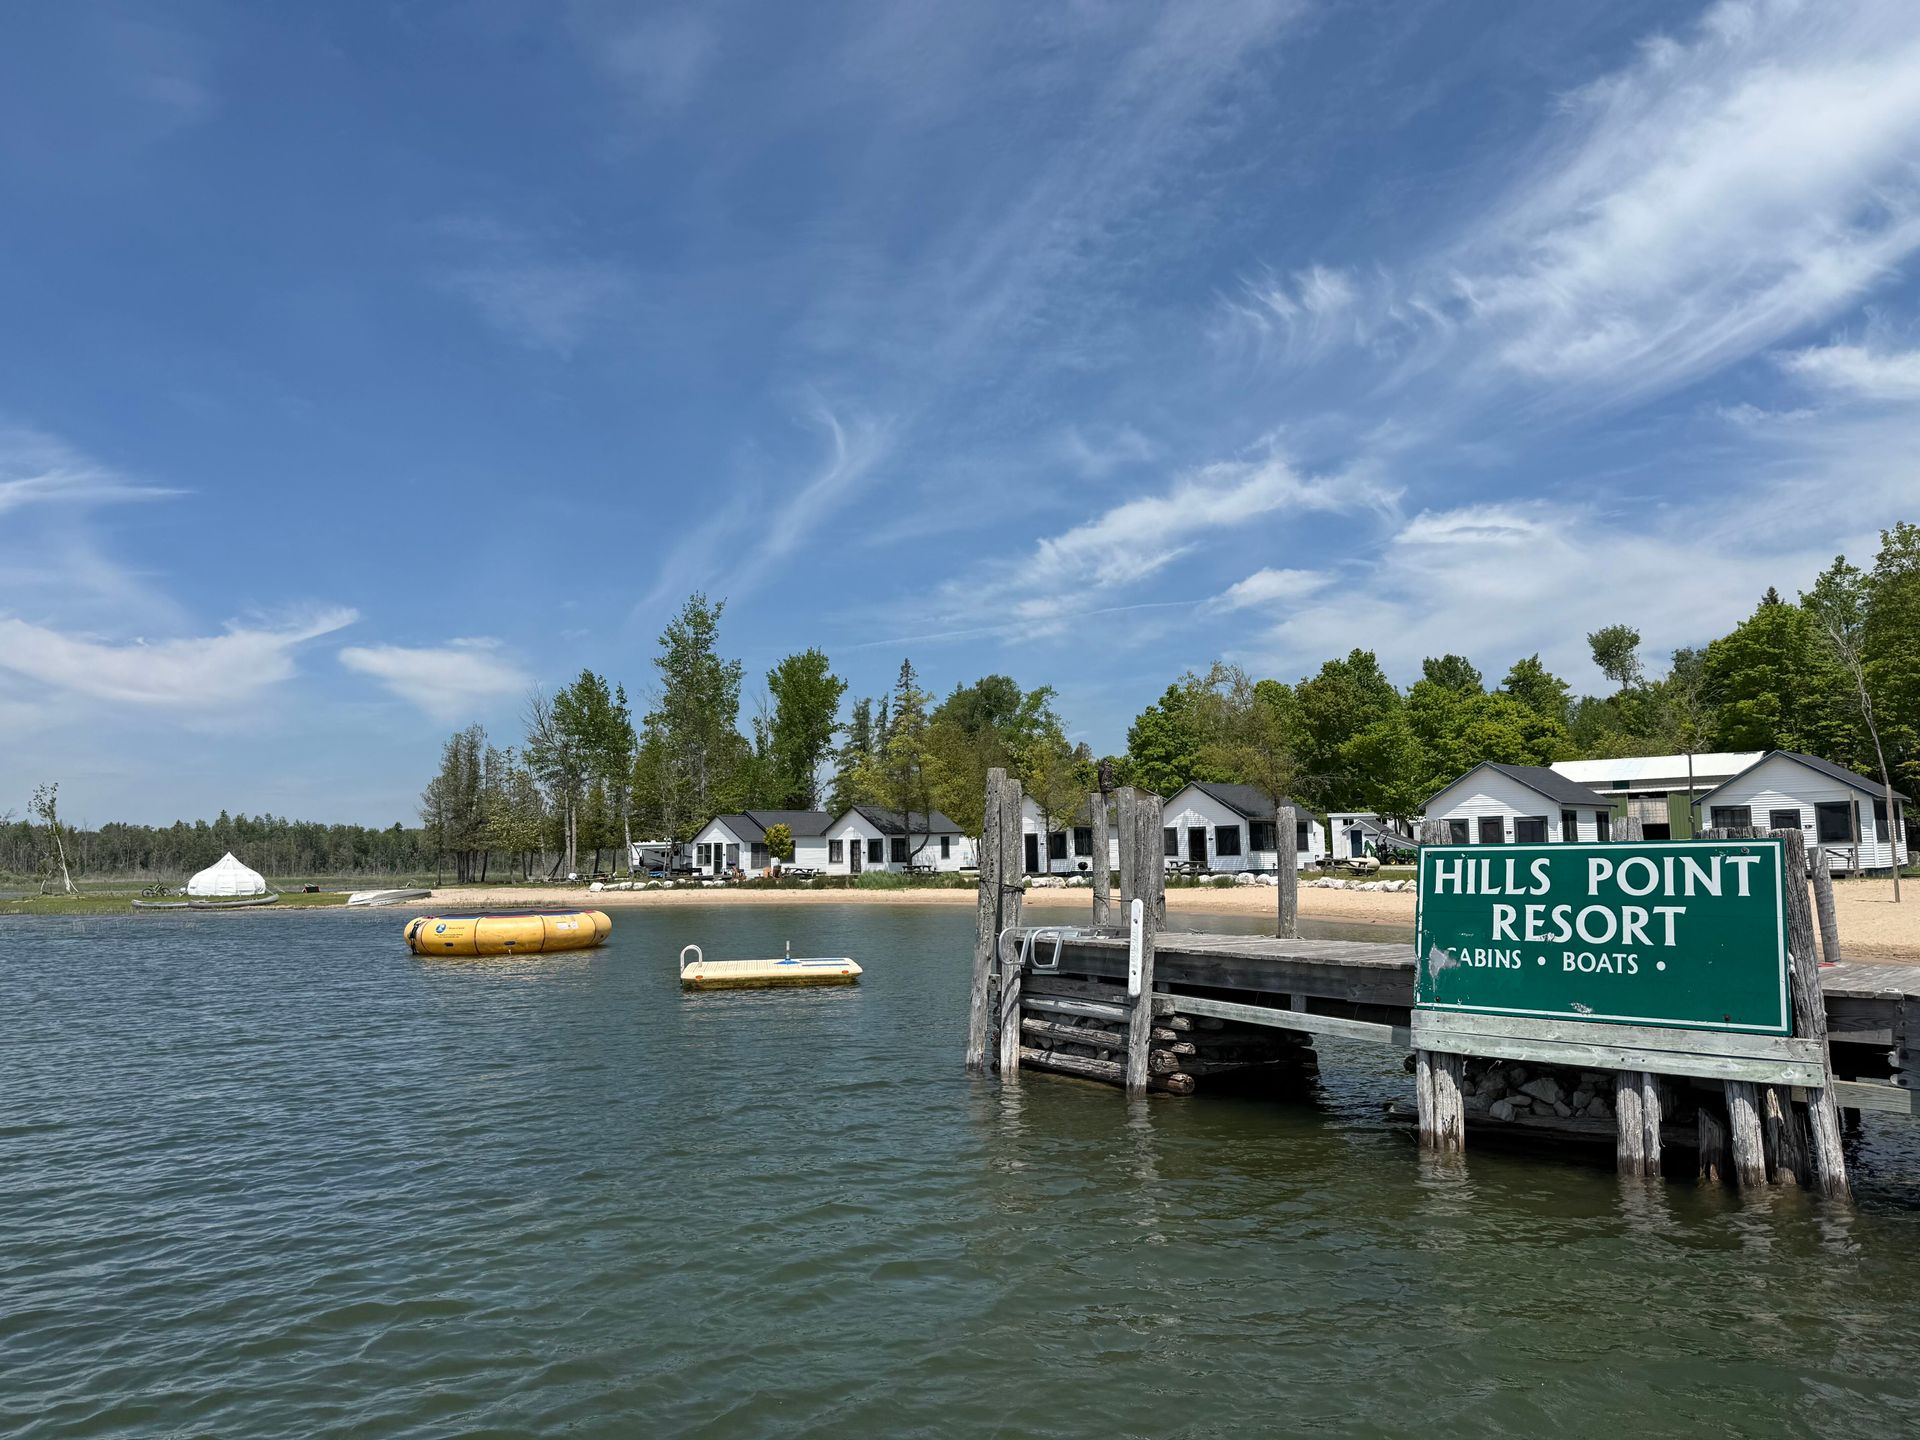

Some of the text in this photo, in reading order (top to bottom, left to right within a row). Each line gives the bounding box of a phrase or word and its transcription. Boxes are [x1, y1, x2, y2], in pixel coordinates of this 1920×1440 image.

[1435, 856, 1761, 896] HILLS POINT
[1492, 904, 1686, 946] RESORT
[1563, 951, 1639, 974] BOATS
